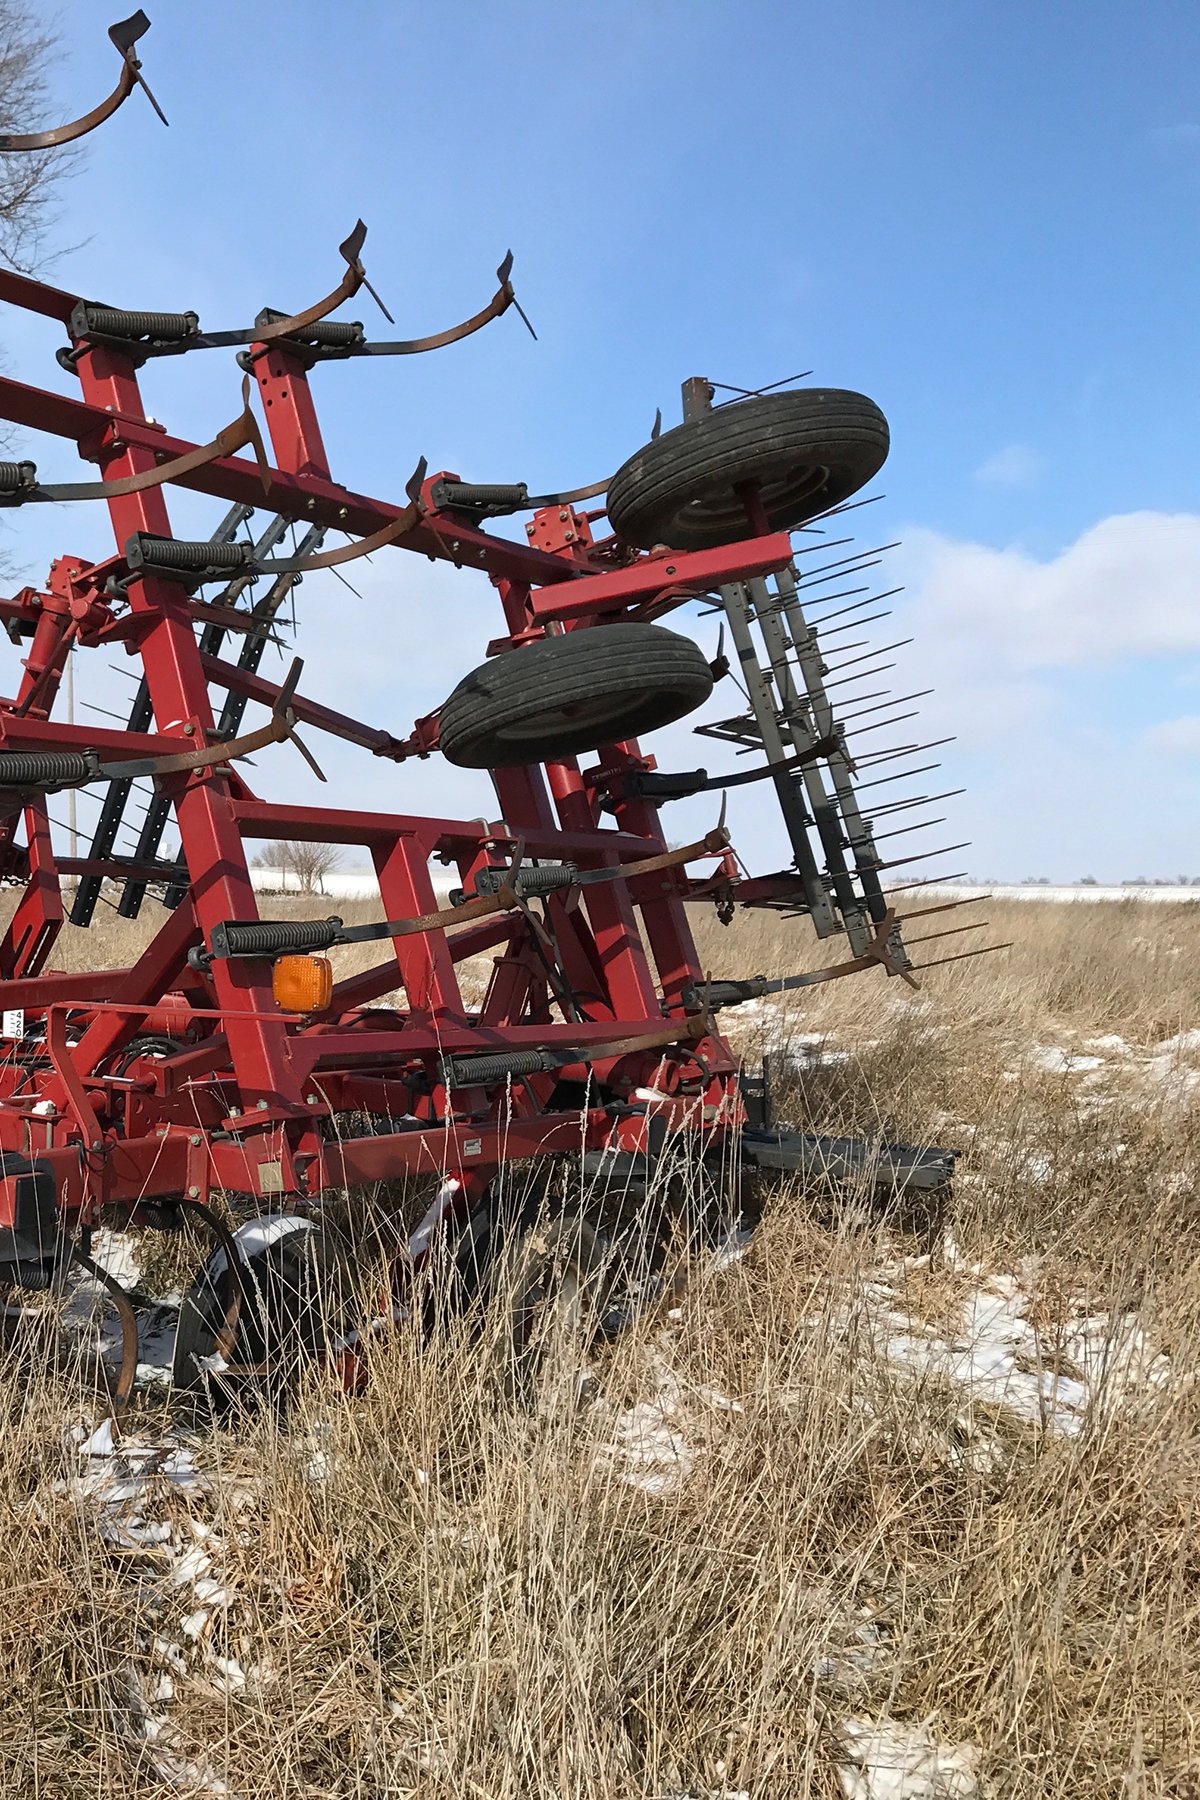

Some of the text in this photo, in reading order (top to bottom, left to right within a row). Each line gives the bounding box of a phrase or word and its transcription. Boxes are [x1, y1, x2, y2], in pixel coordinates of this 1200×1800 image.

[16, 1011, 22, 1019] 4
[16, 1020, 22, 1028] 2
[16, 1029, 22, 1037] 0
